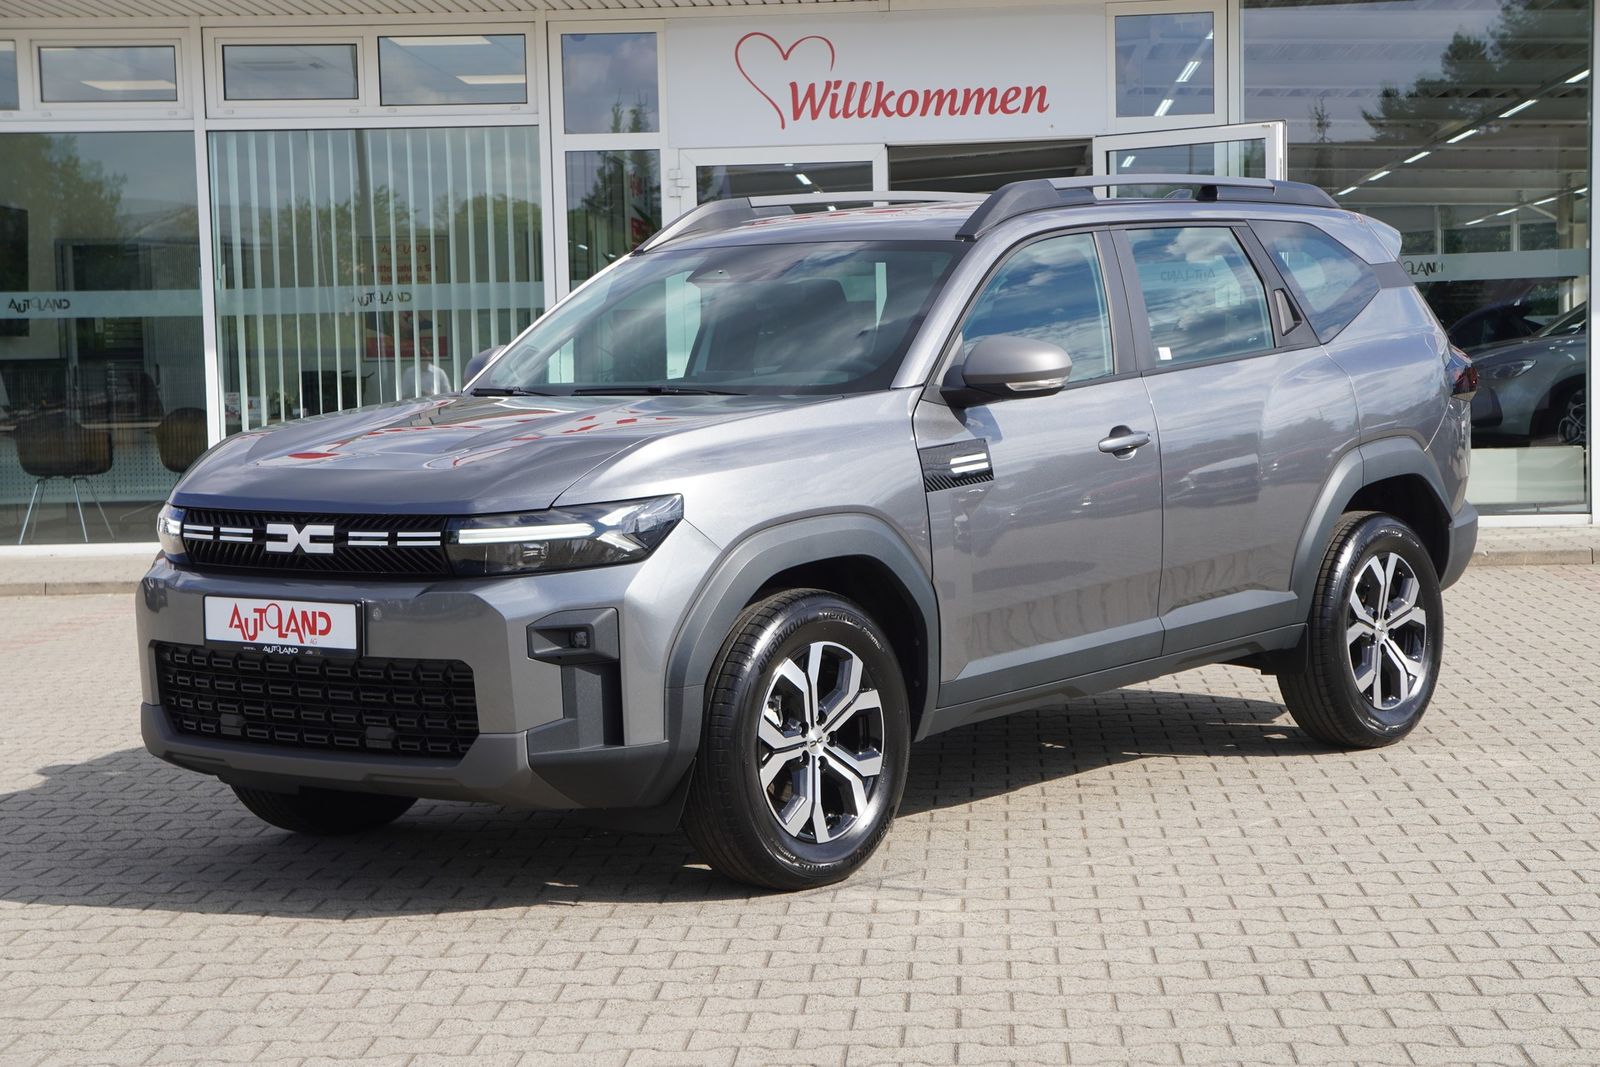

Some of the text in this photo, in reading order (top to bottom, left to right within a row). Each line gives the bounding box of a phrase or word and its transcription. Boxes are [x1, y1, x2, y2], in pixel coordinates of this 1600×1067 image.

[789, 79, 1050, 122] Willkommen
[8, 297, 71, 313] AUTOLAND
[229, 602, 332, 644] AUTOLAND
[262, 644, 299, 656] AUTOLAND
